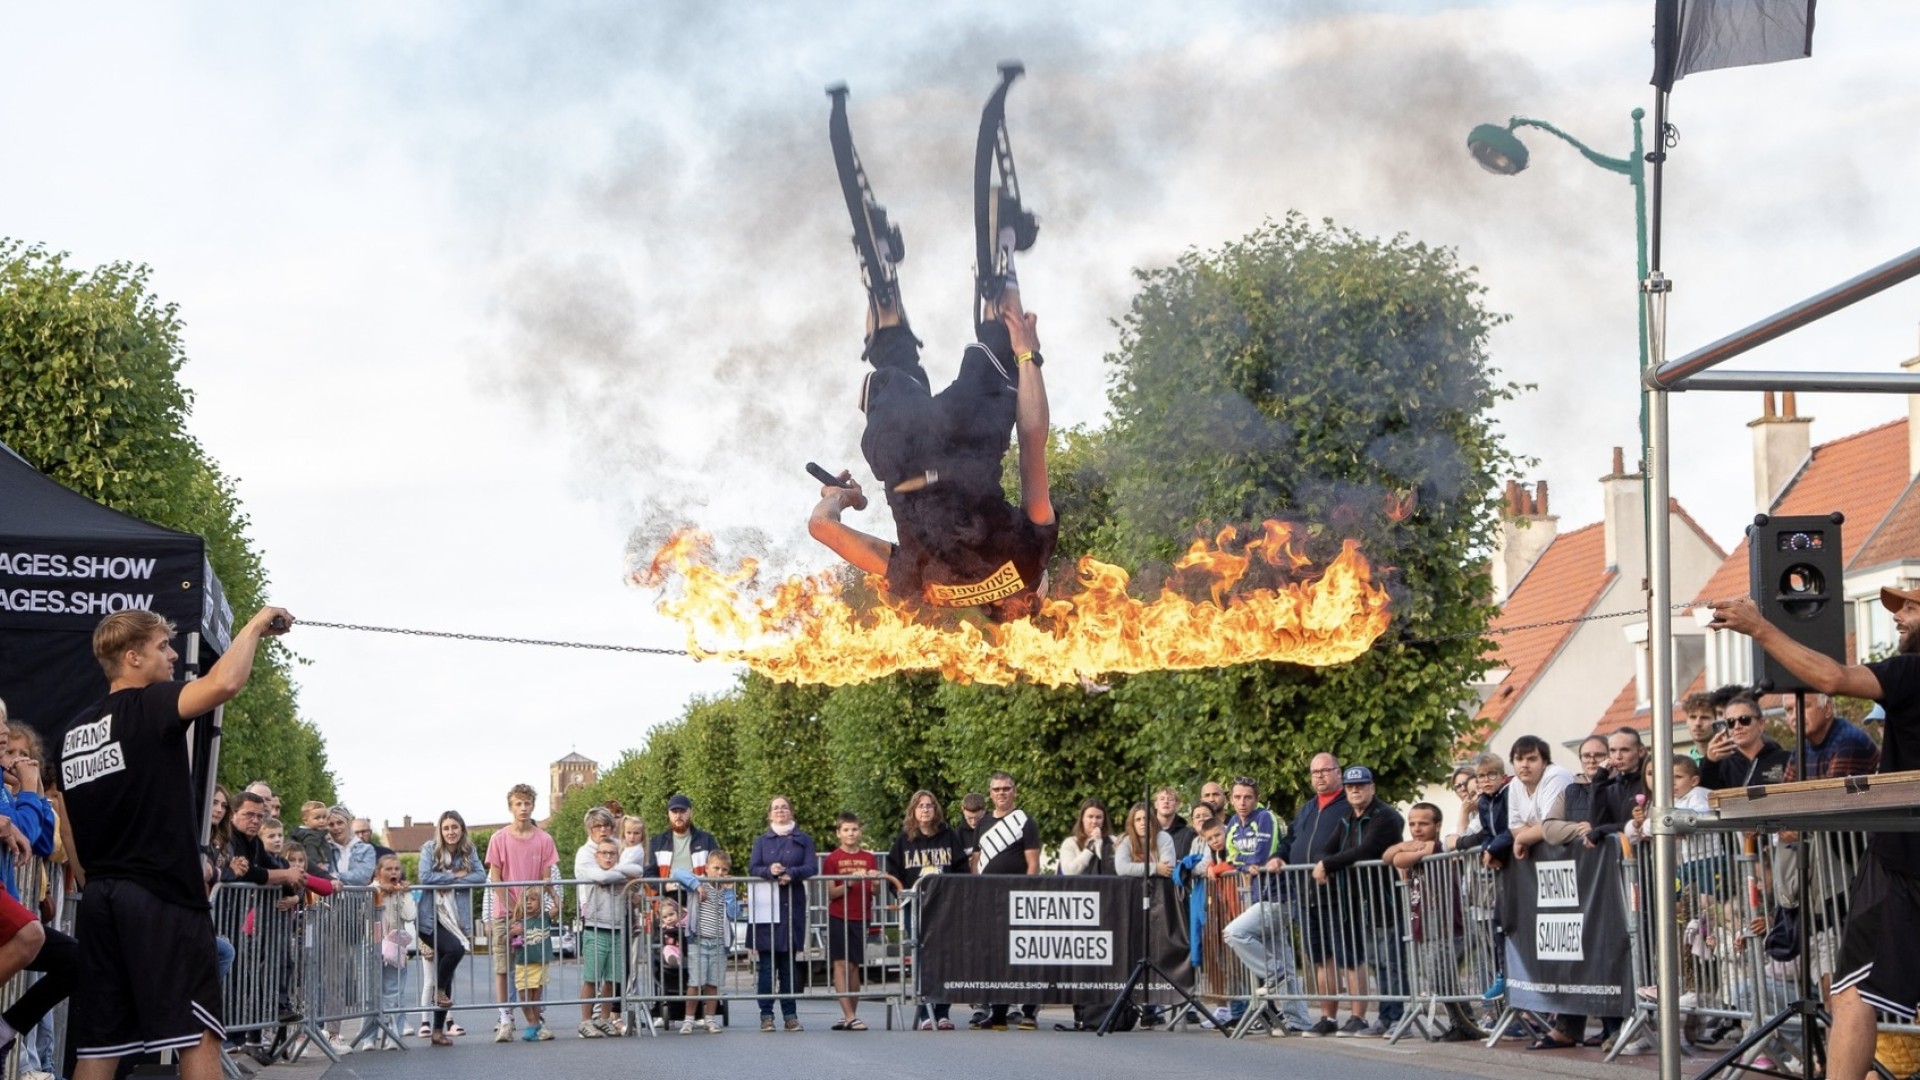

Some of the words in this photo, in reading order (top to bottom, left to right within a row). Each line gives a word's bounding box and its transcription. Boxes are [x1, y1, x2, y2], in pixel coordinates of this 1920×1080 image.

[65, 720, 107, 752] ENFANTS
[65, 748, 120, 784] SAUVAGES
[1539, 868, 1575, 899] ENFANTS
[1015, 896, 1095, 920] ENFANTS
[1015, 936, 1108, 959] SAUVAGES
[1539, 922, 1581, 952] SAUVAGES
[944, 981, 1049, 990] @ENFANTSSAUVAGES.SHOW
